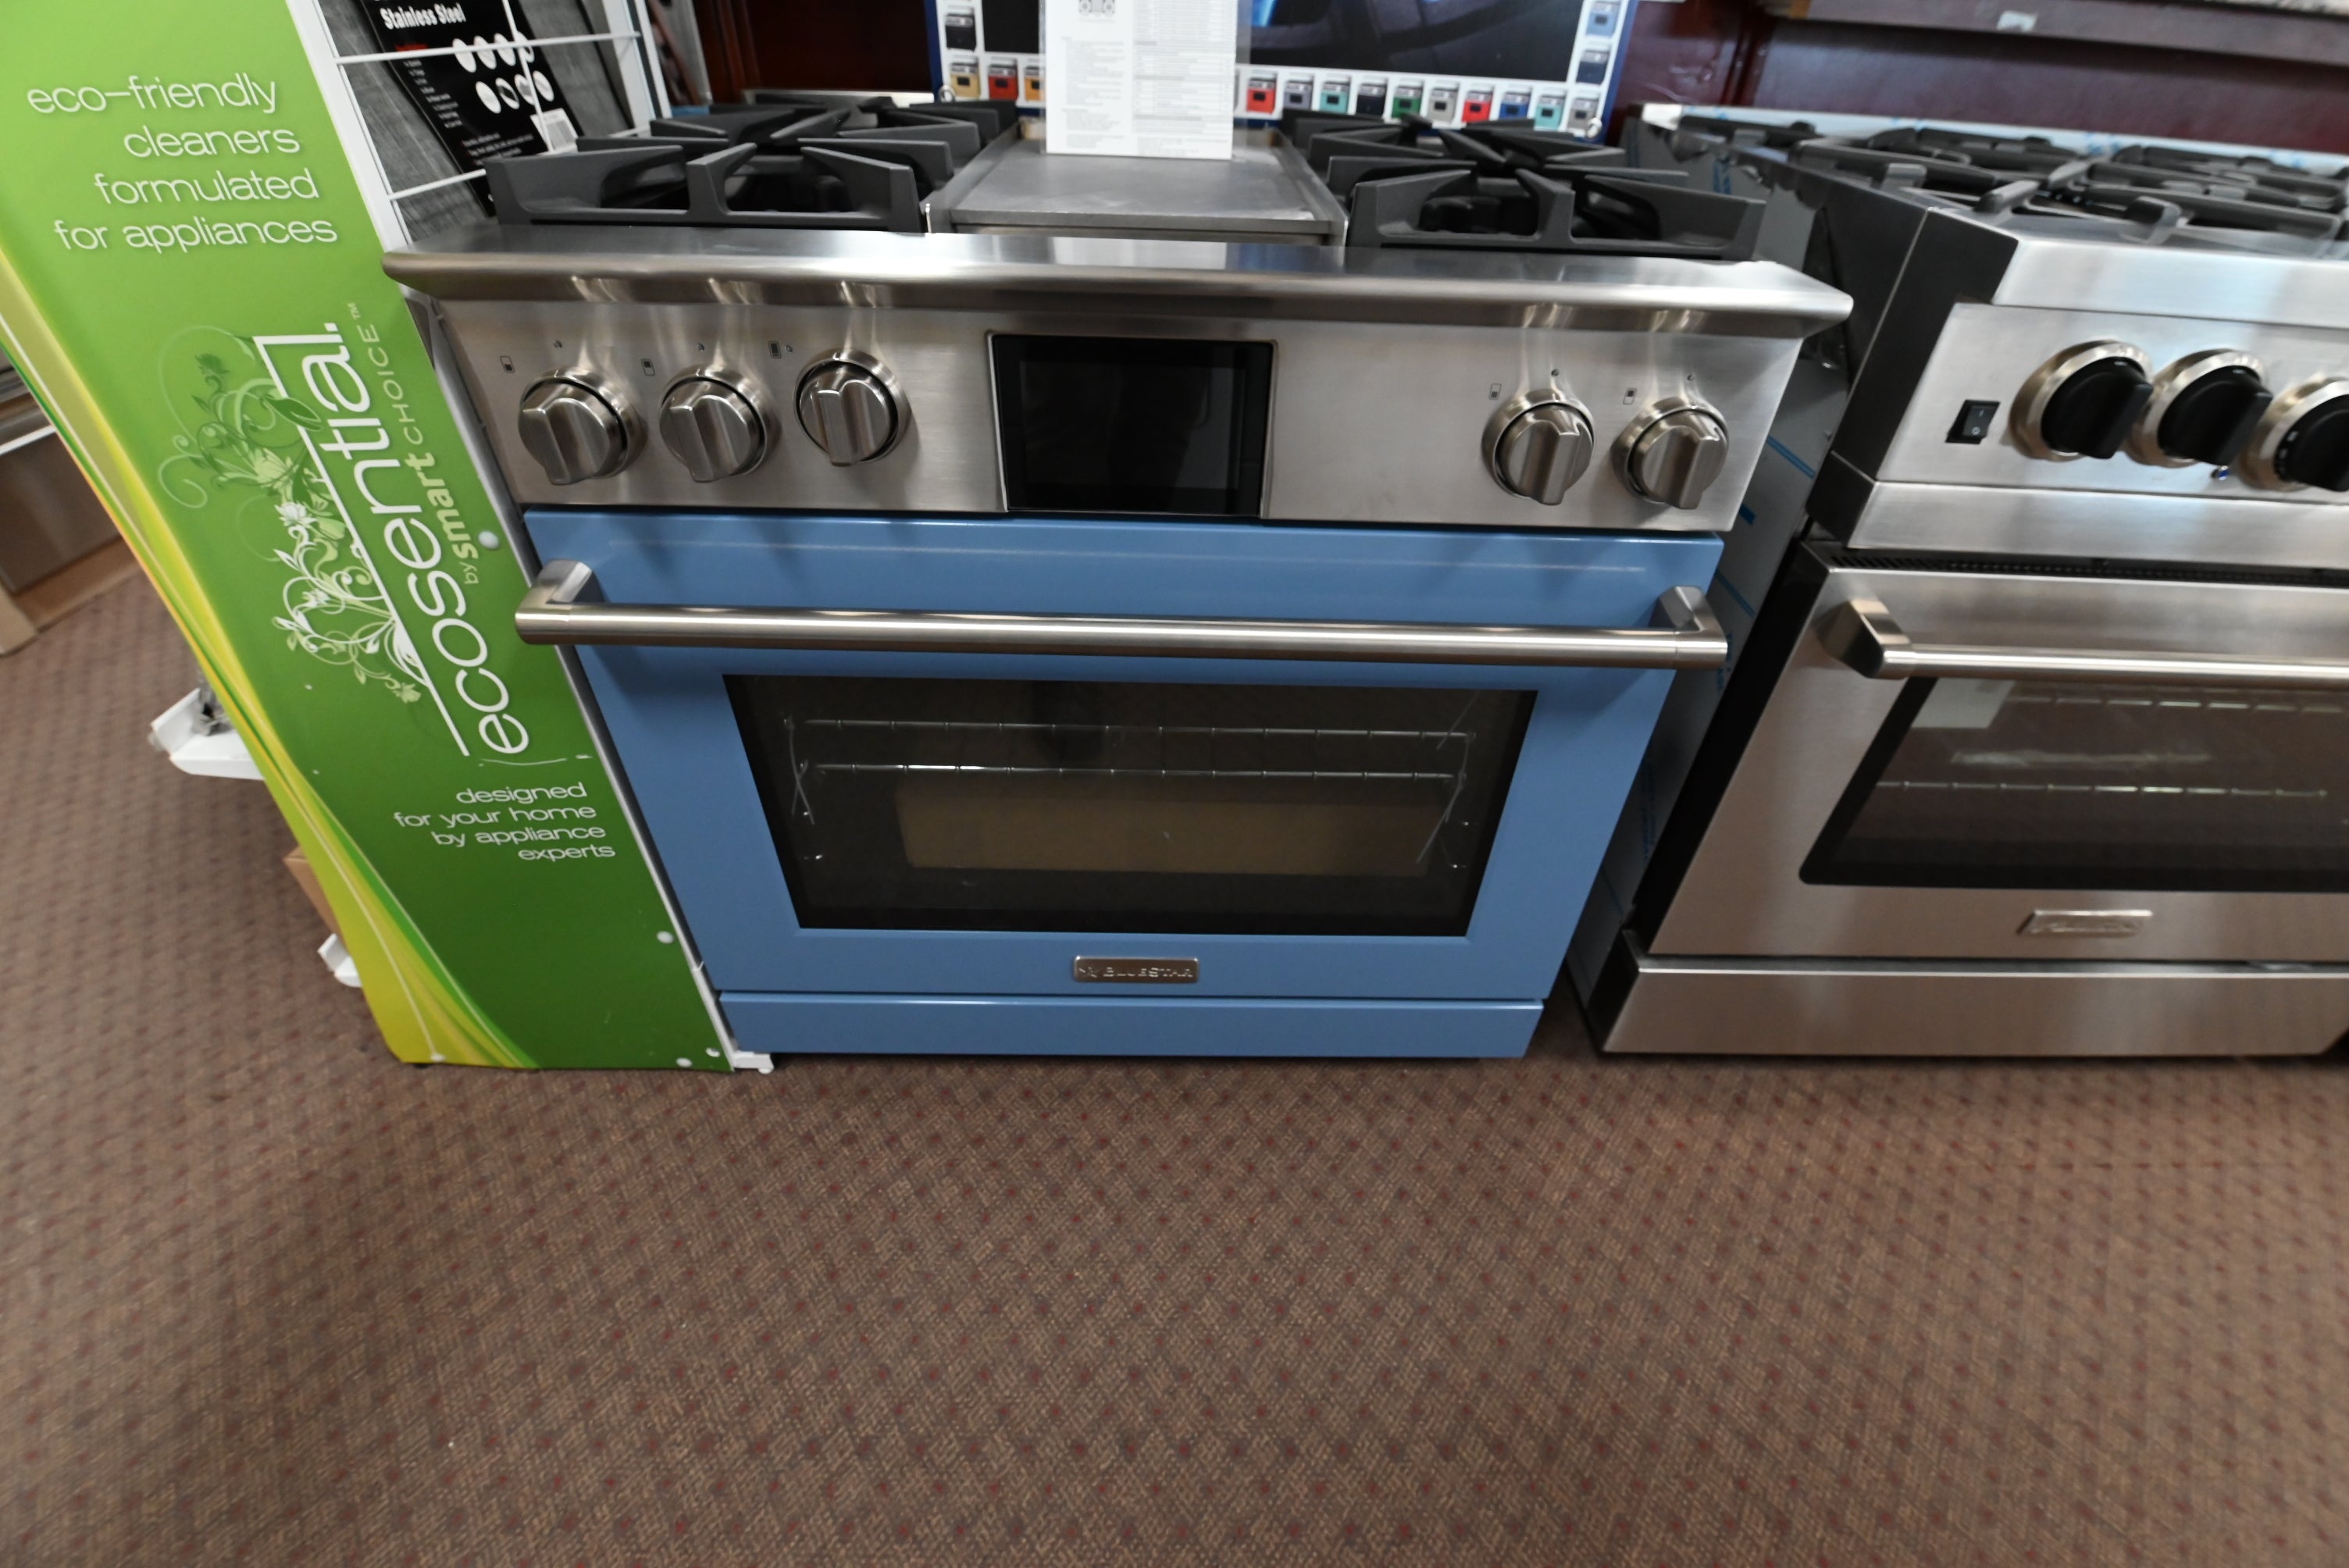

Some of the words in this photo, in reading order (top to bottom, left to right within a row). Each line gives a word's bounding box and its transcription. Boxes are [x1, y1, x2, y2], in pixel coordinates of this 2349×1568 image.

[380, 5, 438, 30] Stainless
[434, 2, 467, 25] Steel
[27, 72, 276, 115] eco-friendly
[123, 125, 301, 158] cleaners
[94, 167, 320, 205] formulated
[54, 219, 108, 250] for
[123, 216, 338, 254] appliances
[404, 451, 479, 560] smart
[458, 558, 479, 586] by
[456, 782, 587, 804] designed
[394, 811, 431, 828] for
[440, 811, 501, 829] your
[508, 806, 597, 821] home
[431, 830, 465, 847] by
[475, 826, 606, 846] appliance
[518, 844, 616, 862] experts
